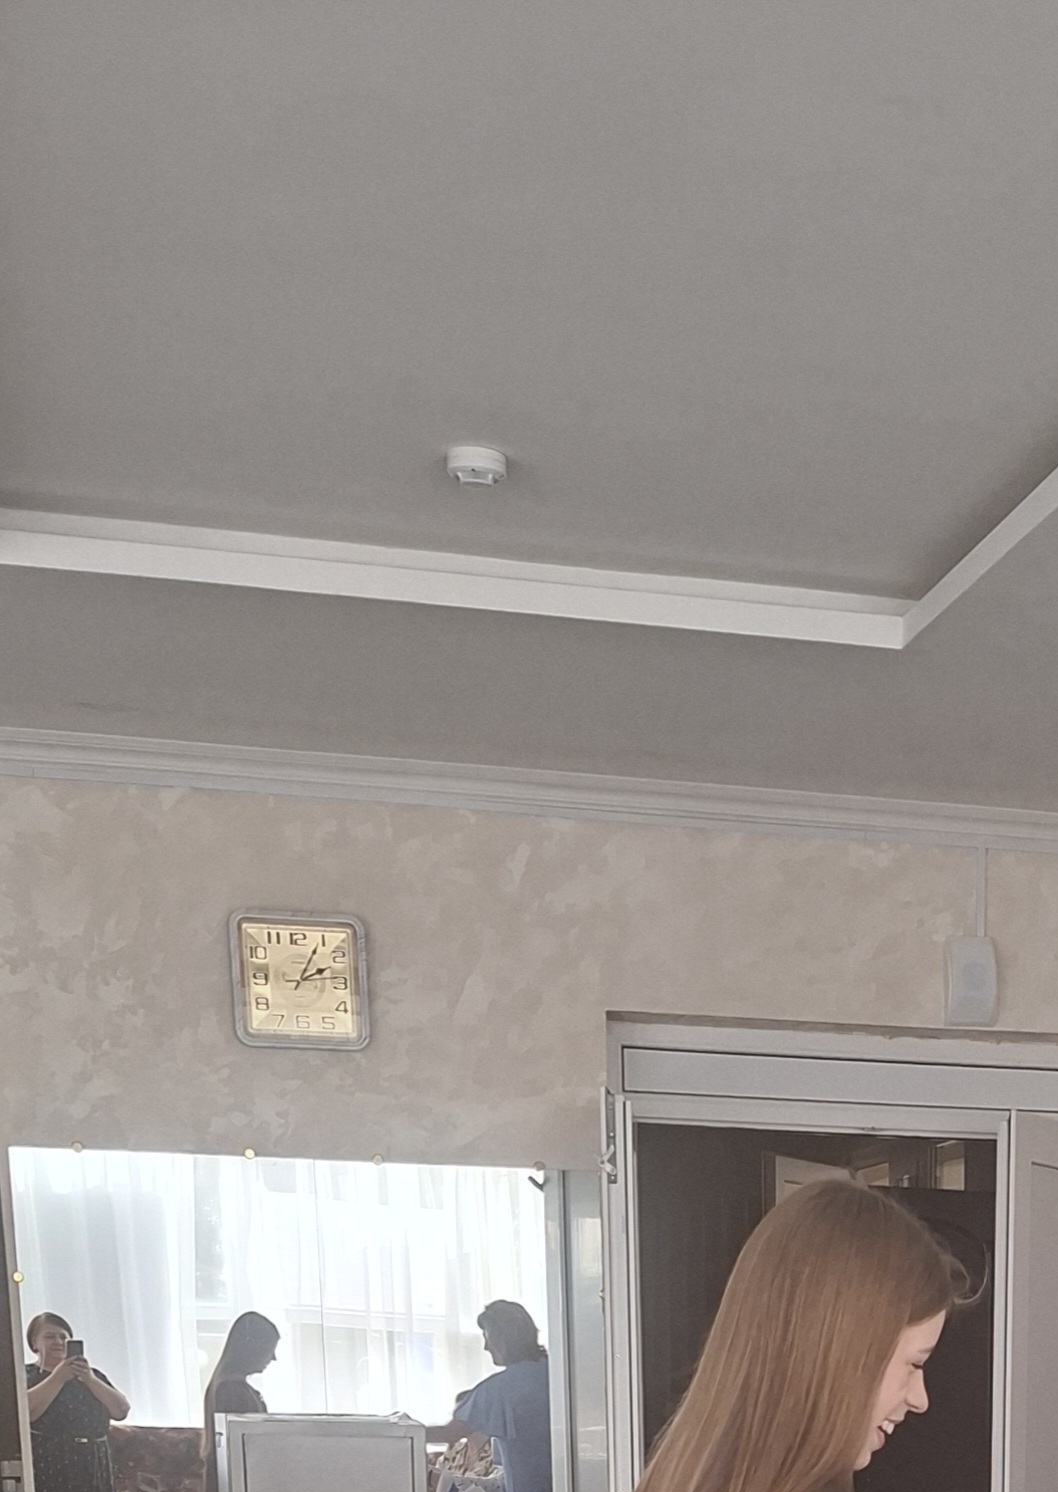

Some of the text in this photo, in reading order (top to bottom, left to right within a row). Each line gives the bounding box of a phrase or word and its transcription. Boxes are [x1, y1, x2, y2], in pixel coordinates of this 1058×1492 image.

[267, 931, 281, 945] 11
[289, 932, 307, 946] 12
[249, 945, 267, 960] 10
[331, 950, 346, 964] 2
[253, 972, 268, 986] 9
[333, 976, 348, 990] 3
[255, 996, 270, 1011] 8
[335, 1000, 349, 1014] 4
[271, 1013, 285, 1028] 7
[296, 1015, 310, 1029] 6
[321, 1016, 335, 1030] 5
